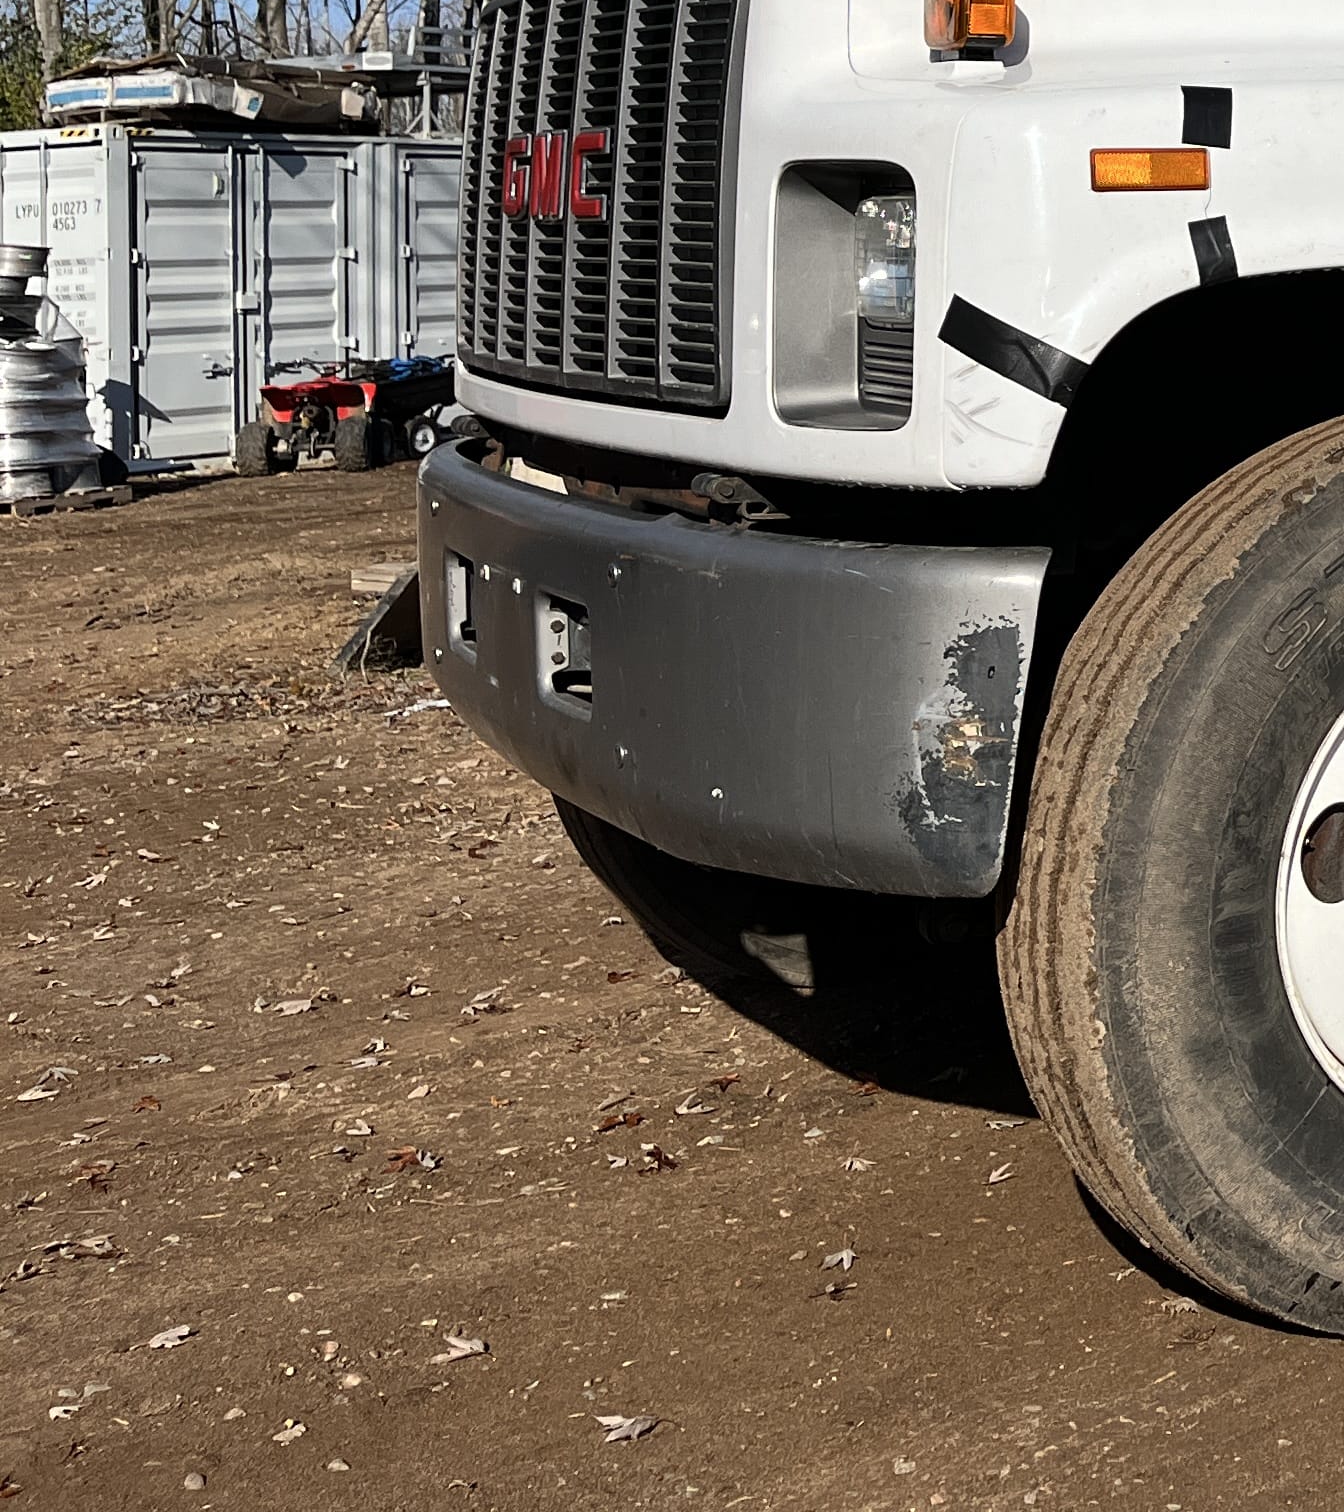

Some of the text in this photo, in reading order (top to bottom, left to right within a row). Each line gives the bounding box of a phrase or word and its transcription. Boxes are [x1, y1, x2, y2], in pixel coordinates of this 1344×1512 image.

[502, 127, 611, 223] GMC
[15, 198, 102, 219] LYPU 010273 7
